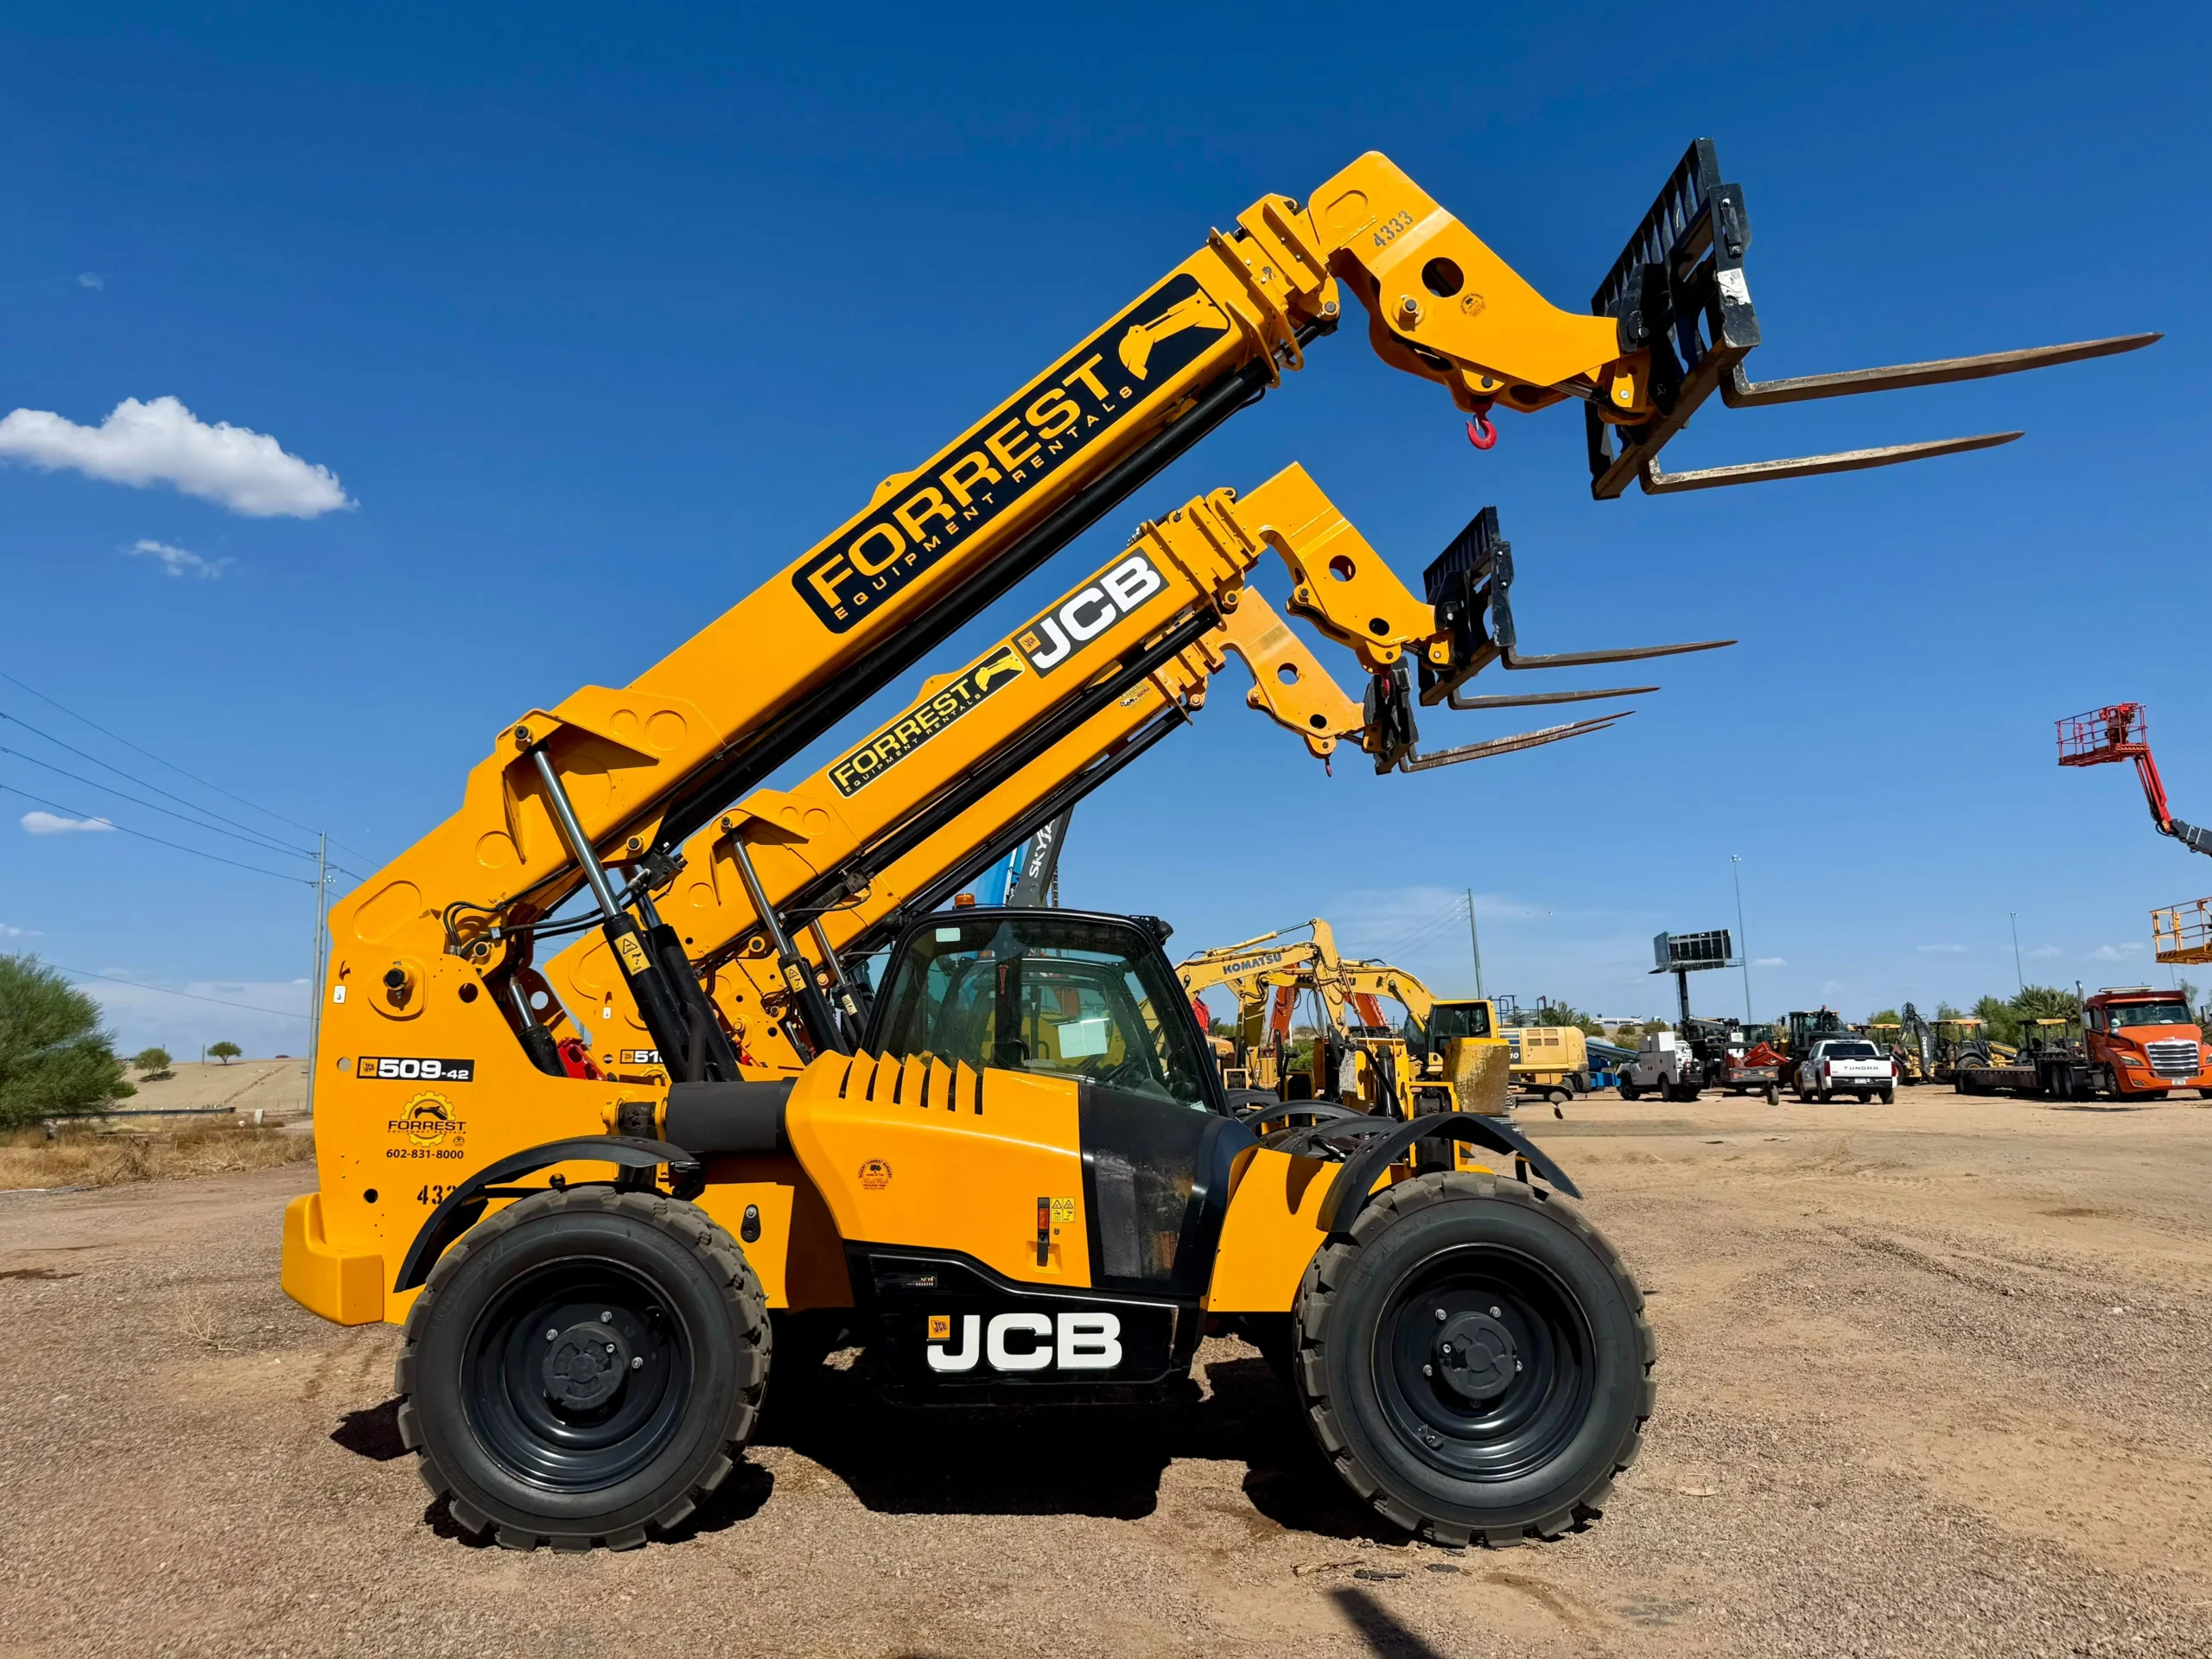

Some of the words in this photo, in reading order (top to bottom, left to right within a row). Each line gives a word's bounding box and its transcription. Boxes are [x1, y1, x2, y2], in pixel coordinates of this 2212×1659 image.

[1373, 210, 1414, 248] 4333
[806, 353, 1109, 609] FORREST
[834, 493, 995, 620] EQUIPMENT
[1012, 385, 1133, 483] RENTALS
[1031, 556, 1162, 670] JCB
[834, 678, 974, 788] FORREST
[845, 738, 918, 793] EQUIPMENT
[925, 693, 982, 735] RENTALS
[1223, 953, 1282, 975] KOMATSU
[378, 1059, 469, 1079] 509-42
[634, 1051, 663, 1063] 51
[388, 1121, 467, 1130] FORREST
[386, 1149, 464, 1160] 602-831-8000
[926, 1313, 1122, 1372] JCB
[934, 1321, 947, 1332] JCB
